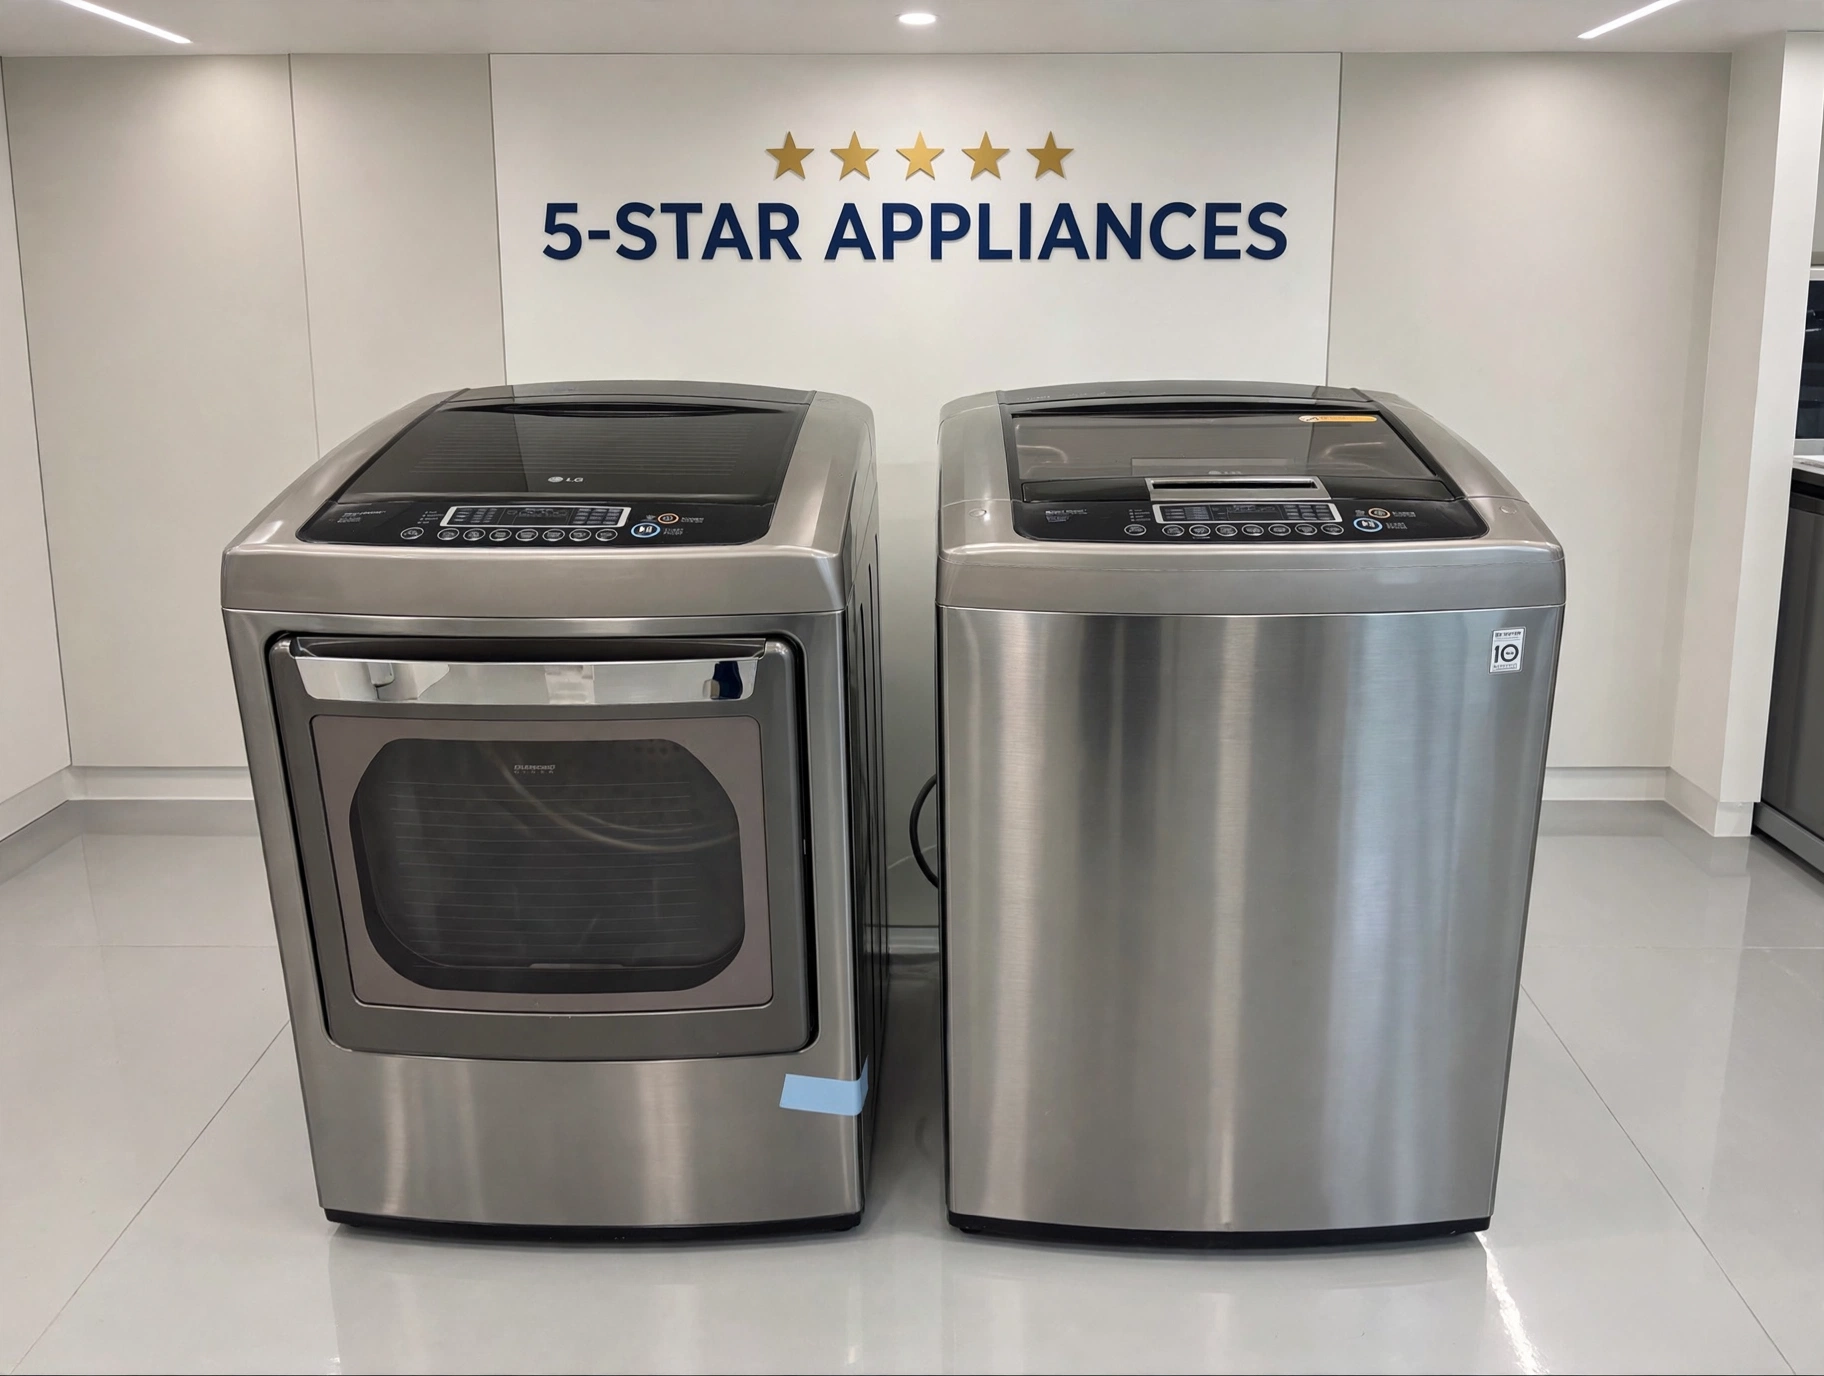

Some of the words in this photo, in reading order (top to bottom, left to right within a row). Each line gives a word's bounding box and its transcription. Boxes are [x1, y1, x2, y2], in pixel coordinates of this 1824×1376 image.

[542, 202, 801, 260] 5-STAR
[824, 202, 1288, 260] APPLIANCES
[1494, 643, 1520, 664] 10
